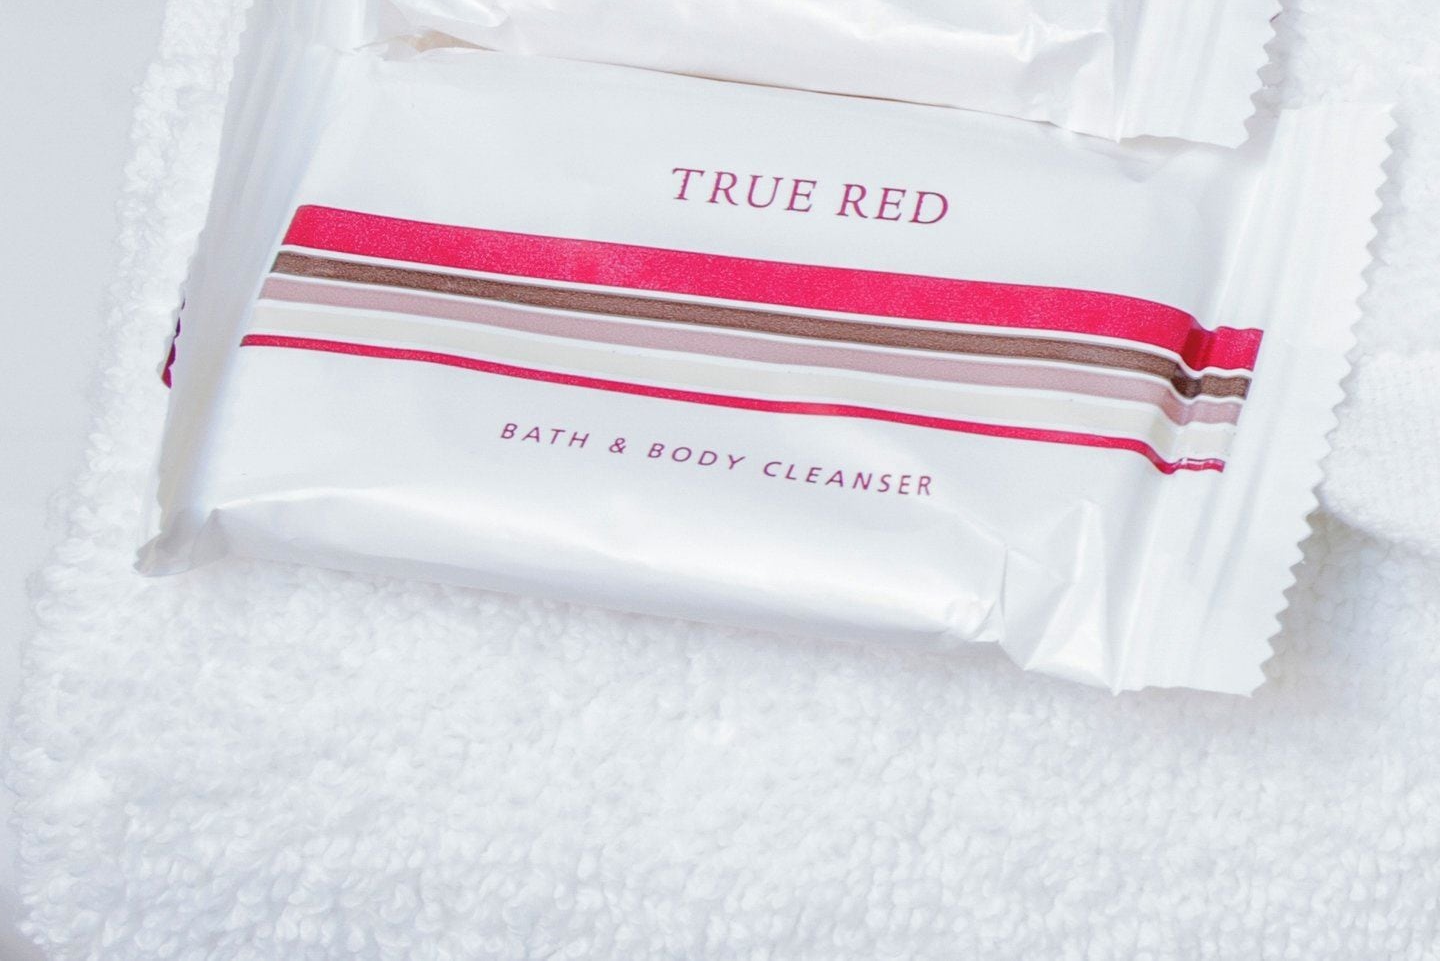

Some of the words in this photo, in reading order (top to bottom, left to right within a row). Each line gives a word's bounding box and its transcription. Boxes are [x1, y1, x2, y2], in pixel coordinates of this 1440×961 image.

[671, 167, 818, 213] TRUE
[835, 182, 949, 225] RED
[500, 422, 590, 450] BATH
[608, 437, 627, 455] &
[647, 442, 746, 471] BODY
[762, 460, 933, 497] CLEANSER
